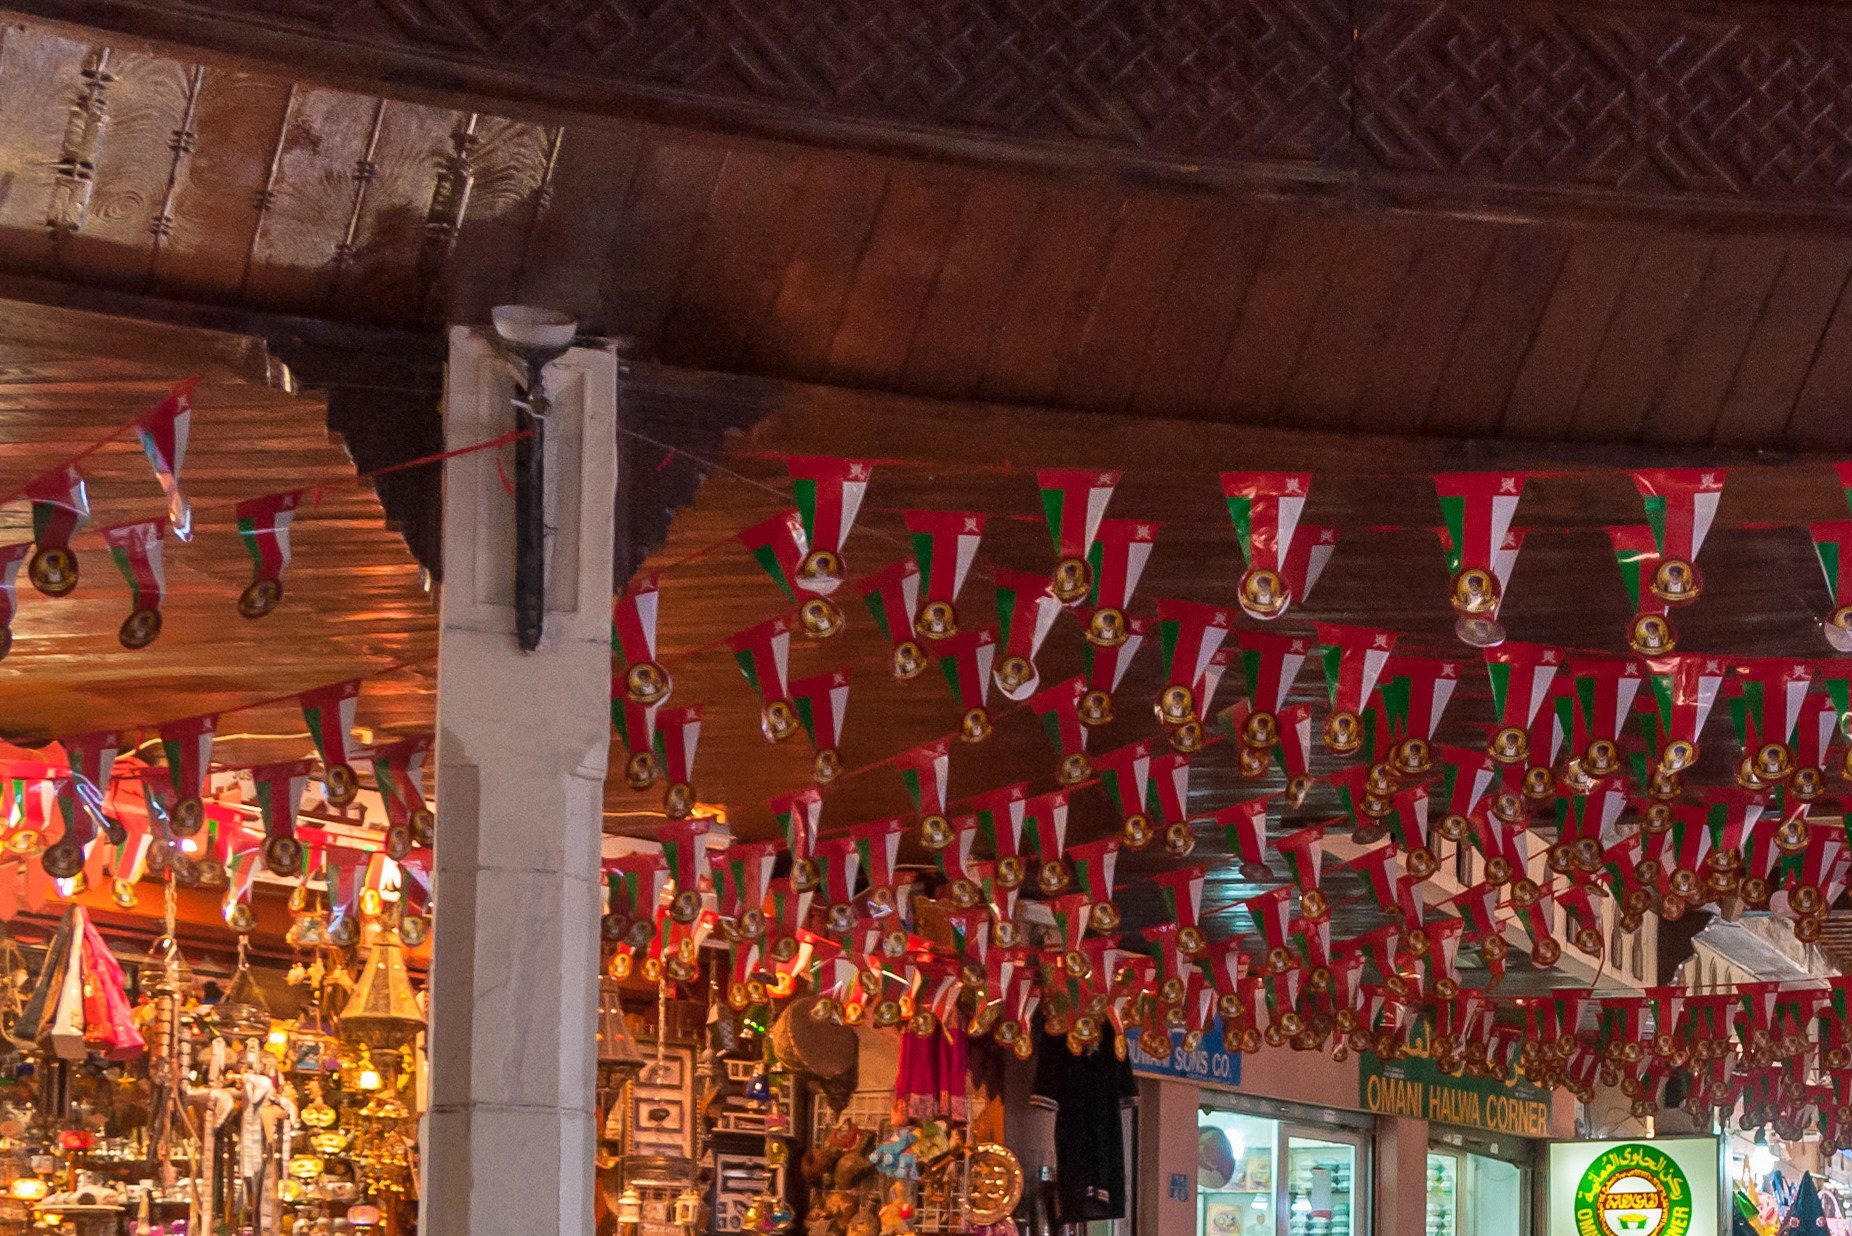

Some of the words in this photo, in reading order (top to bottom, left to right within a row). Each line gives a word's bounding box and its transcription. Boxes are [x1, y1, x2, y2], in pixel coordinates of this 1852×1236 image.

[1367, 1074, 1422, 1118] OMANI
[1428, 1085, 1480, 1126] HALWA
[1486, 1094, 1549, 1136] CORNER
